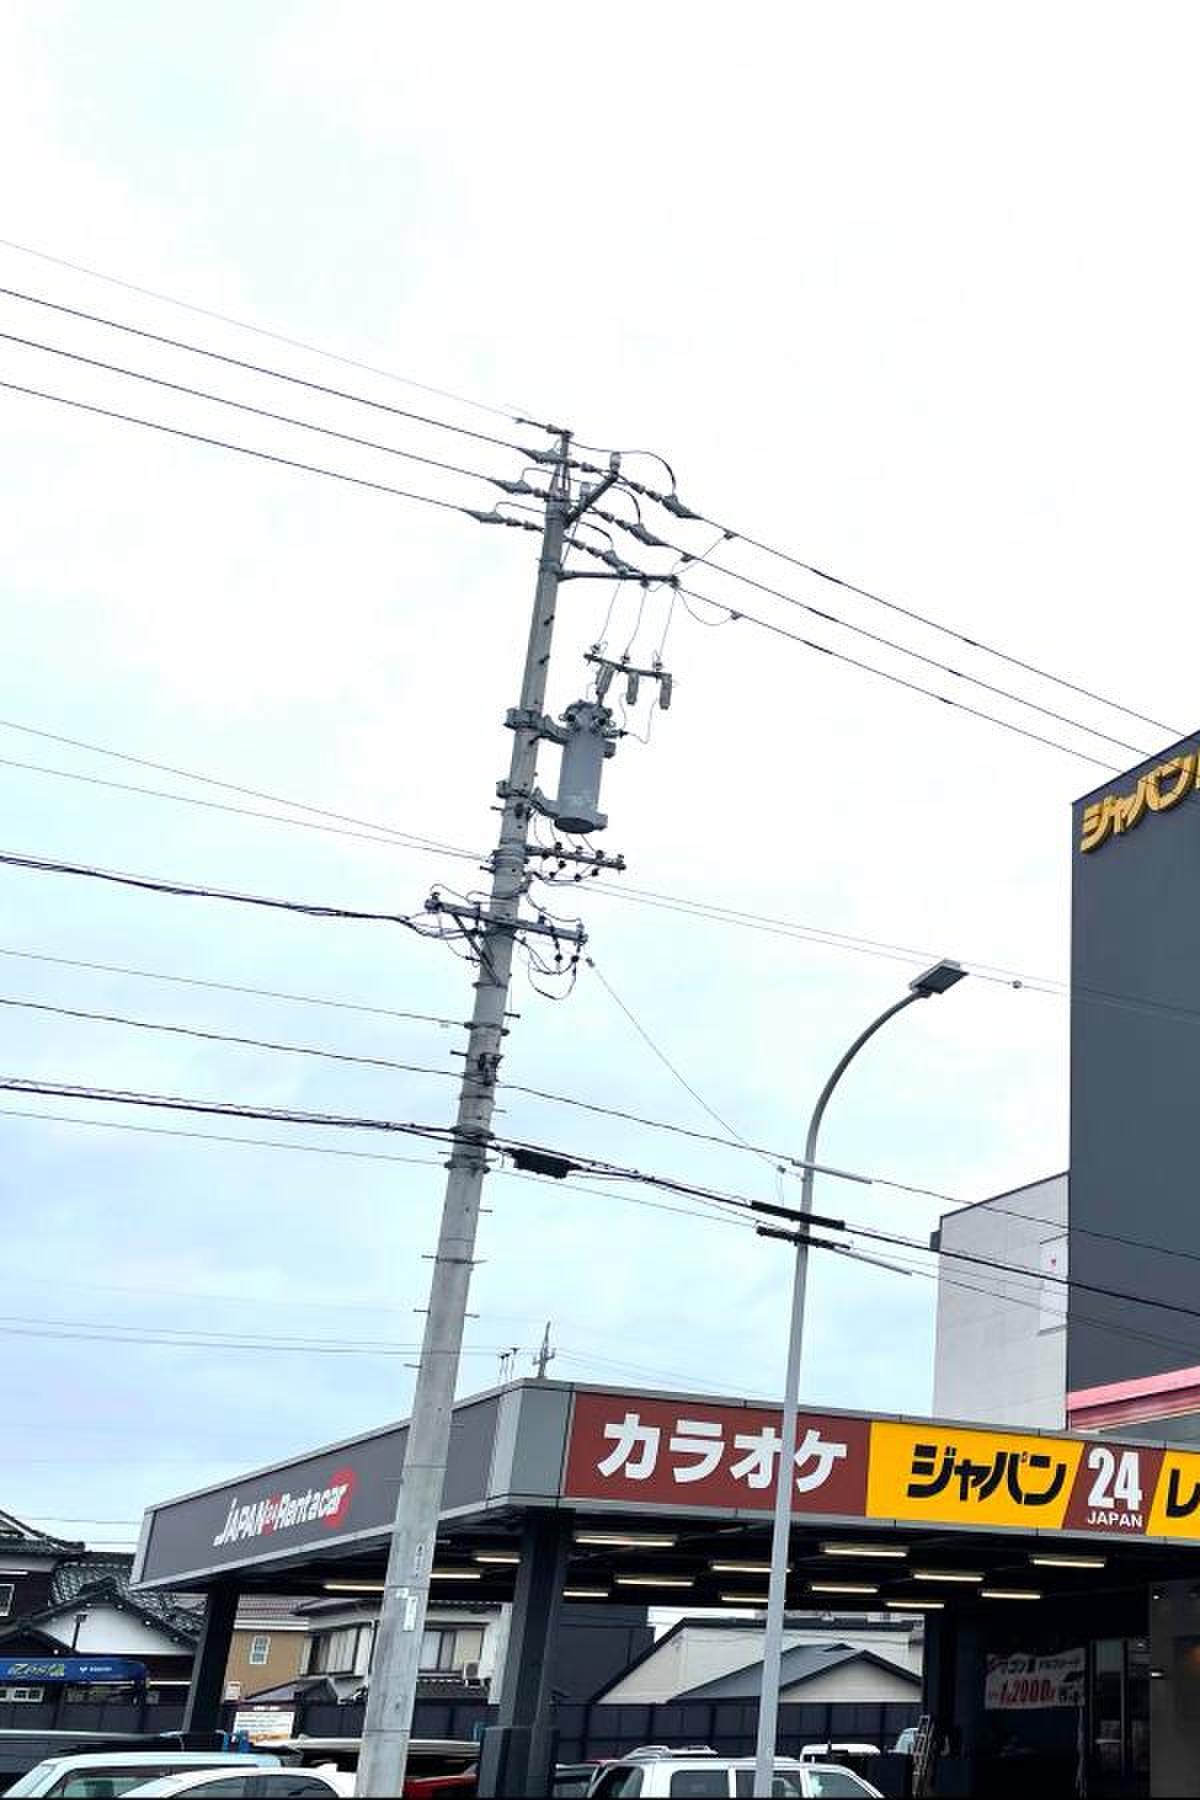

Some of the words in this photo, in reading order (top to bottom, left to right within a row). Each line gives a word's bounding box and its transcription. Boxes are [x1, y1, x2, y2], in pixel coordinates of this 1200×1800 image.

[597, 1413, 848, 1492] カラオケ
[907, 1443, 1067, 1506] ジャパン
[1088, 1447, 1142, 1510] 24
[1087, 1511, 1143, 1528] JAPAN
